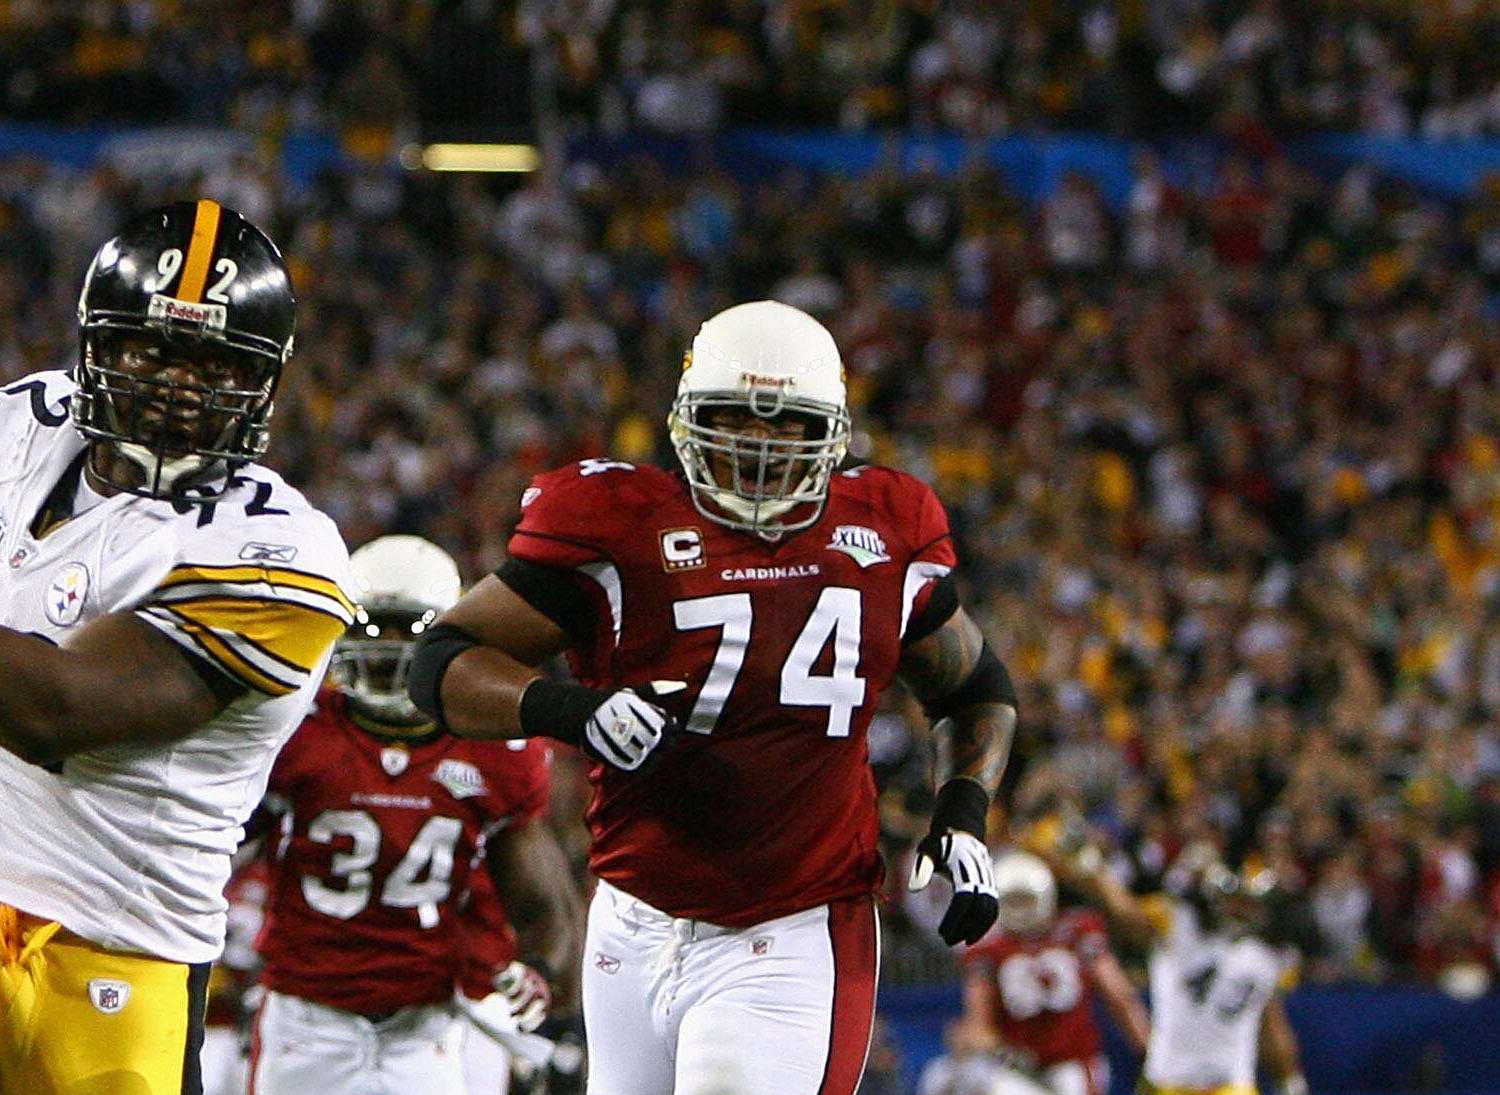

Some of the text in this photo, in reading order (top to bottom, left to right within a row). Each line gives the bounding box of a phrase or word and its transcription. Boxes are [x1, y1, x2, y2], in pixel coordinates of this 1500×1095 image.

[663, 530, 702, 561] C
[836, 531, 882, 558] XLIII
[721, 564, 820, 581] CARDINALS
[673, 586, 866, 738] 74
[301, 809, 463, 929] 34
